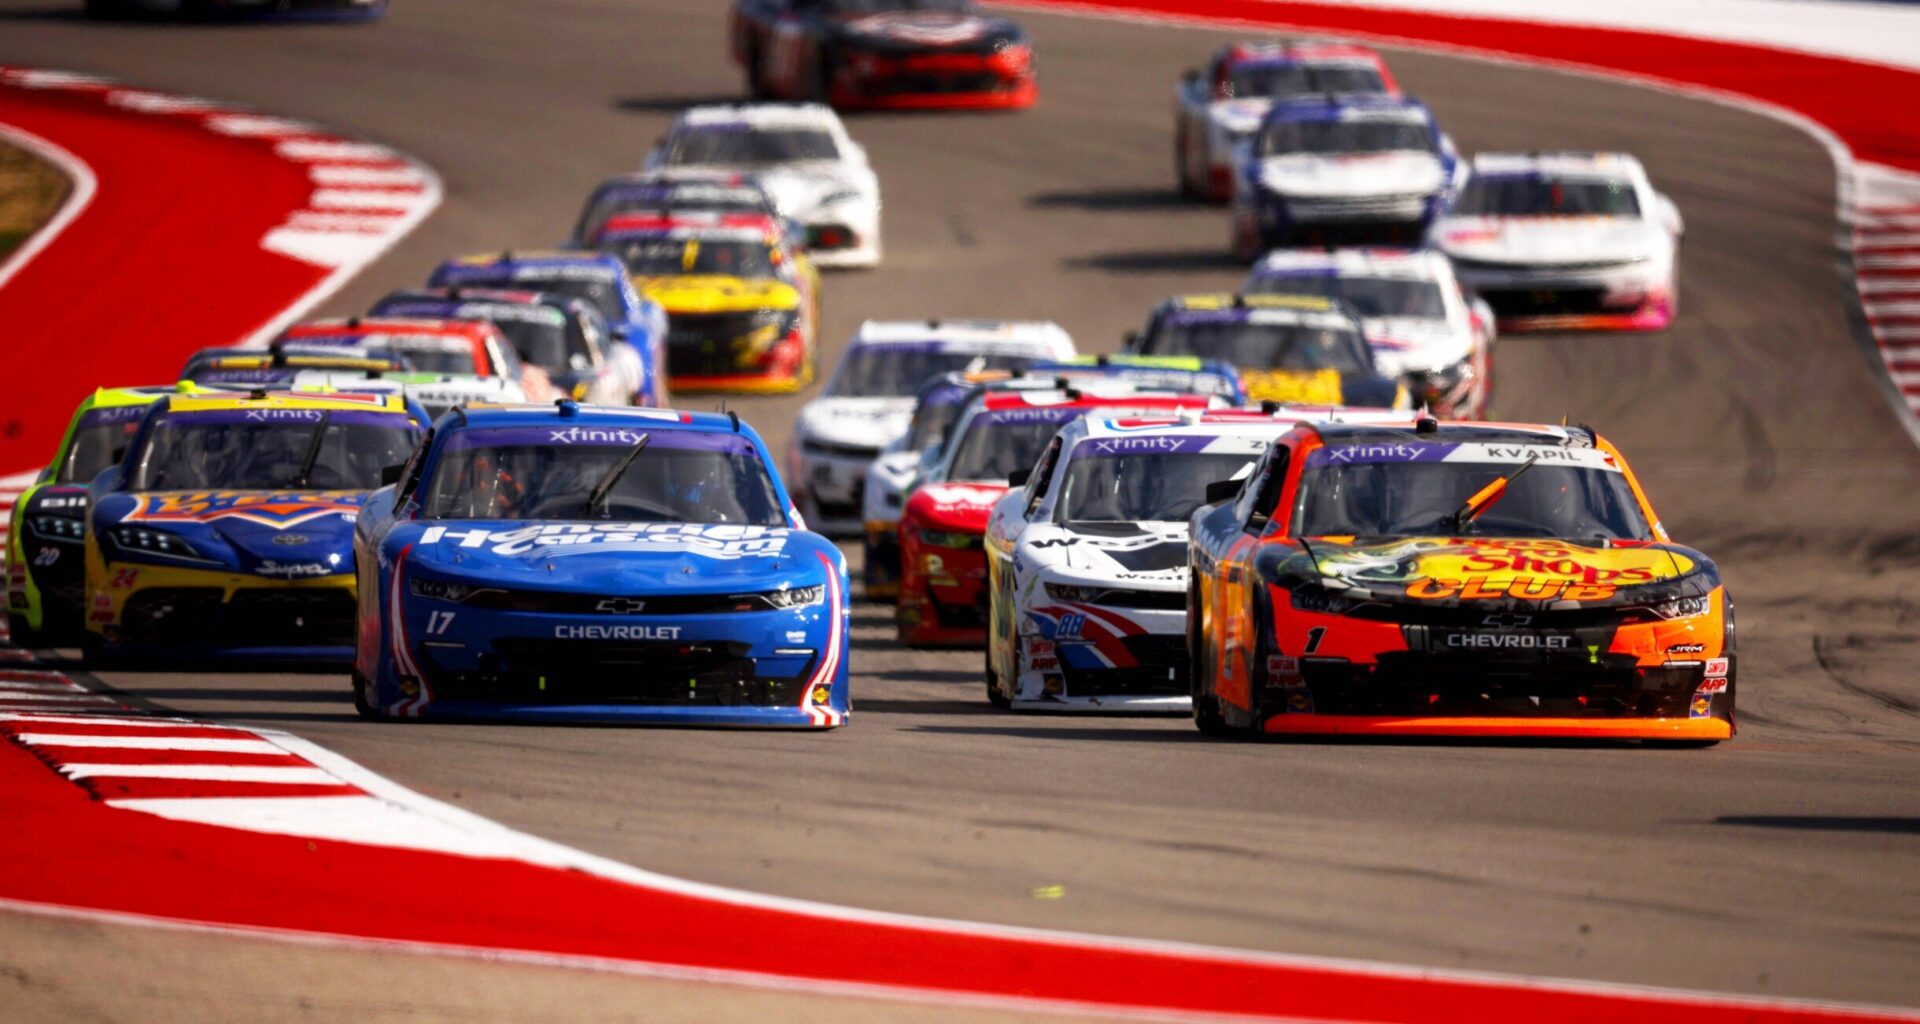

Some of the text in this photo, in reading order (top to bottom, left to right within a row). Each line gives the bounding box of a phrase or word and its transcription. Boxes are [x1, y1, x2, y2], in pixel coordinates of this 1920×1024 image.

[245, 408, 323, 422] xfinity
[991, 409, 1066, 423] xfinity
[548, 427, 649, 445] xfinity
[1095, 435, 1186, 452] xfinity
[1329, 445, 1426, 462] xfinity
[1488, 448, 1582, 461] KVAPIL
[34, 546, 60, 566] 20
[111, 567, 139, 588] 24
[255, 560, 331, 579] Supra
[1462, 554, 1656, 583] Shops
[1405, 576, 1617, 600] CLUB
[426, 610, 456, 635] 17
[1055, 614, 1086, 638] 88
[554, 625, 682, 641] CHEVROLET
[1303, 626, 1328, 656] 1
[1447, 633, 1571, 648] CHEVROLET
[1030, 657, 1058, 670] ARP
